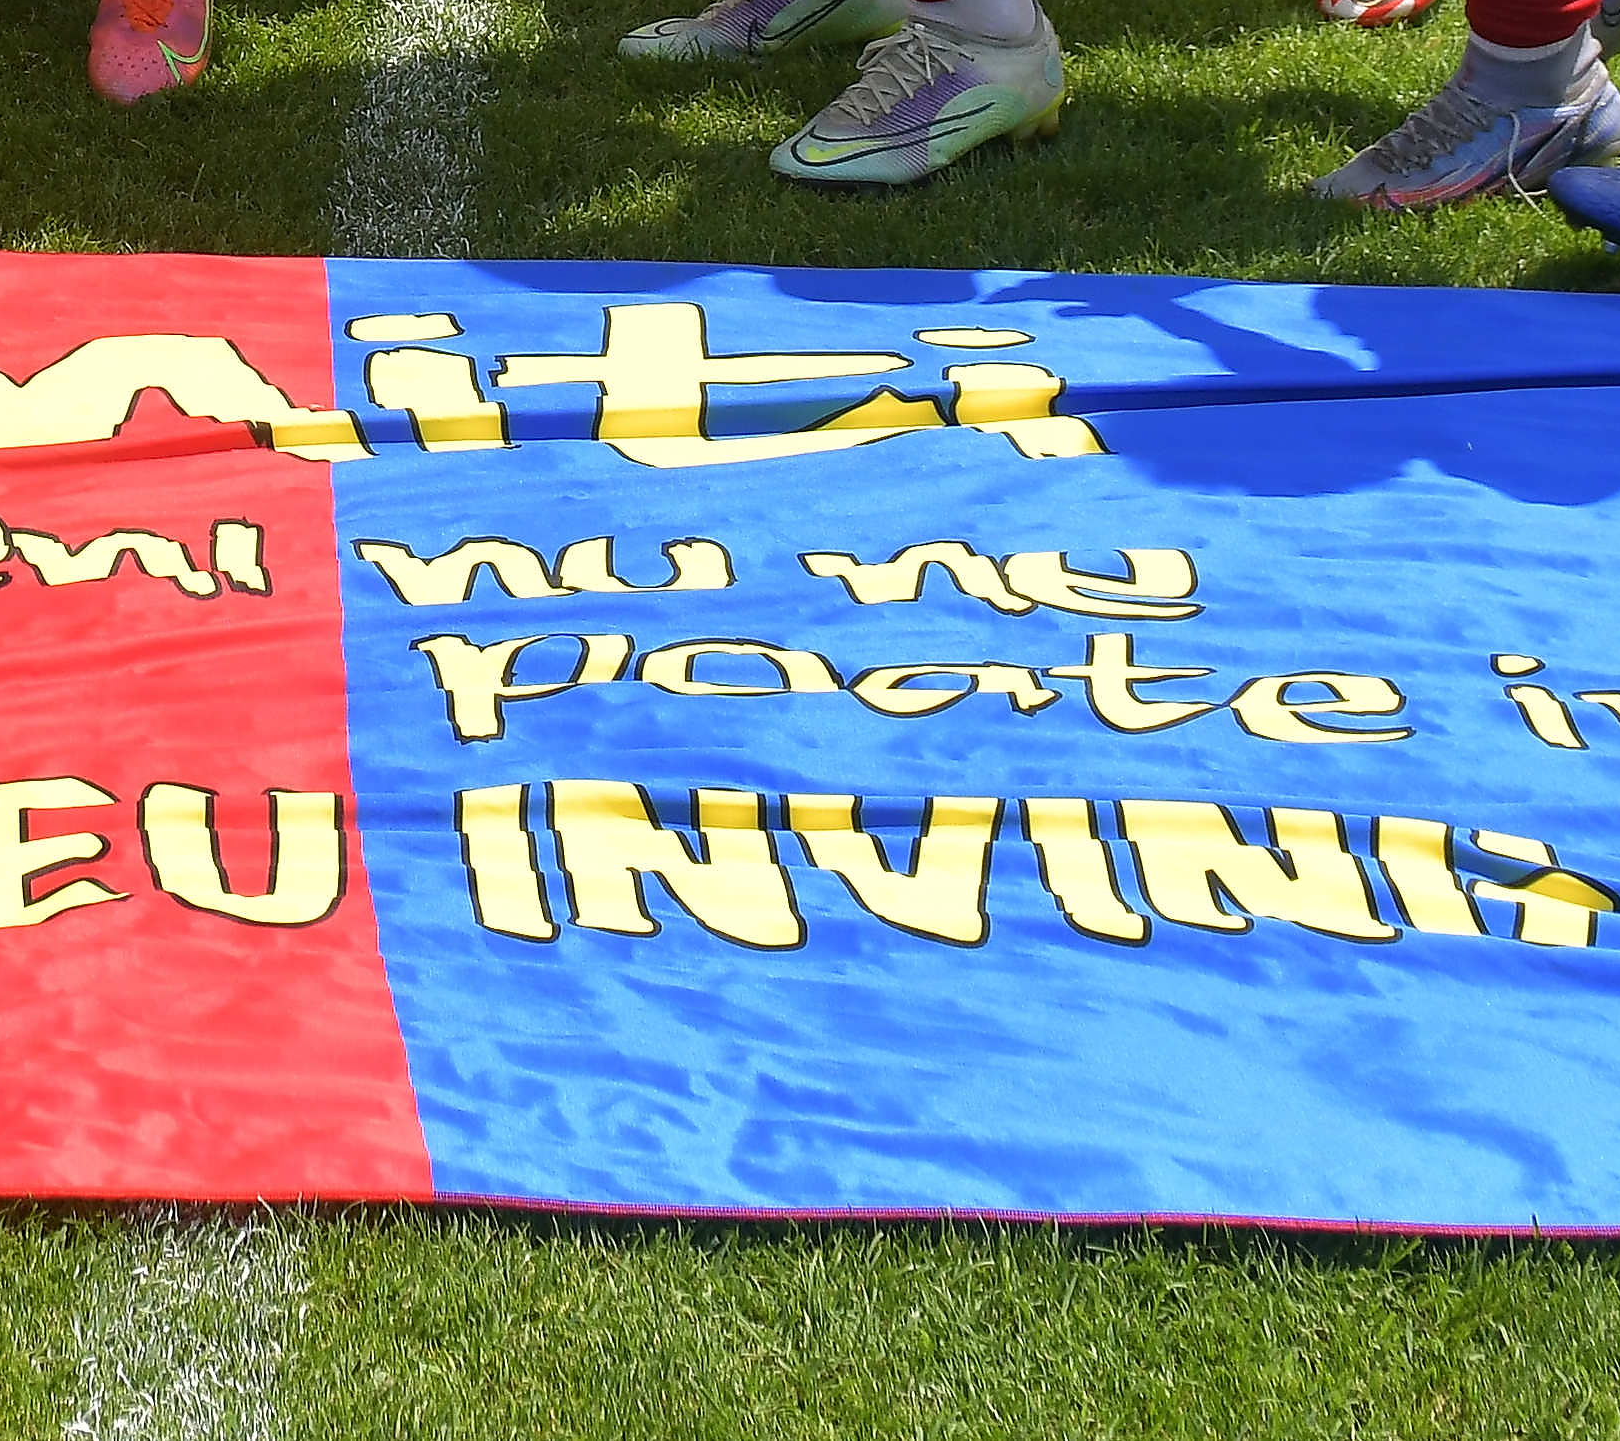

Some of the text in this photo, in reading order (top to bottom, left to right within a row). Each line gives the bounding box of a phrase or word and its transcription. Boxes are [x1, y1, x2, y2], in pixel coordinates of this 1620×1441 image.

[351, 535, 739, 608] nu
[798, 540, 1204, 620] ne
[409, 632, 1415, 745] poate
